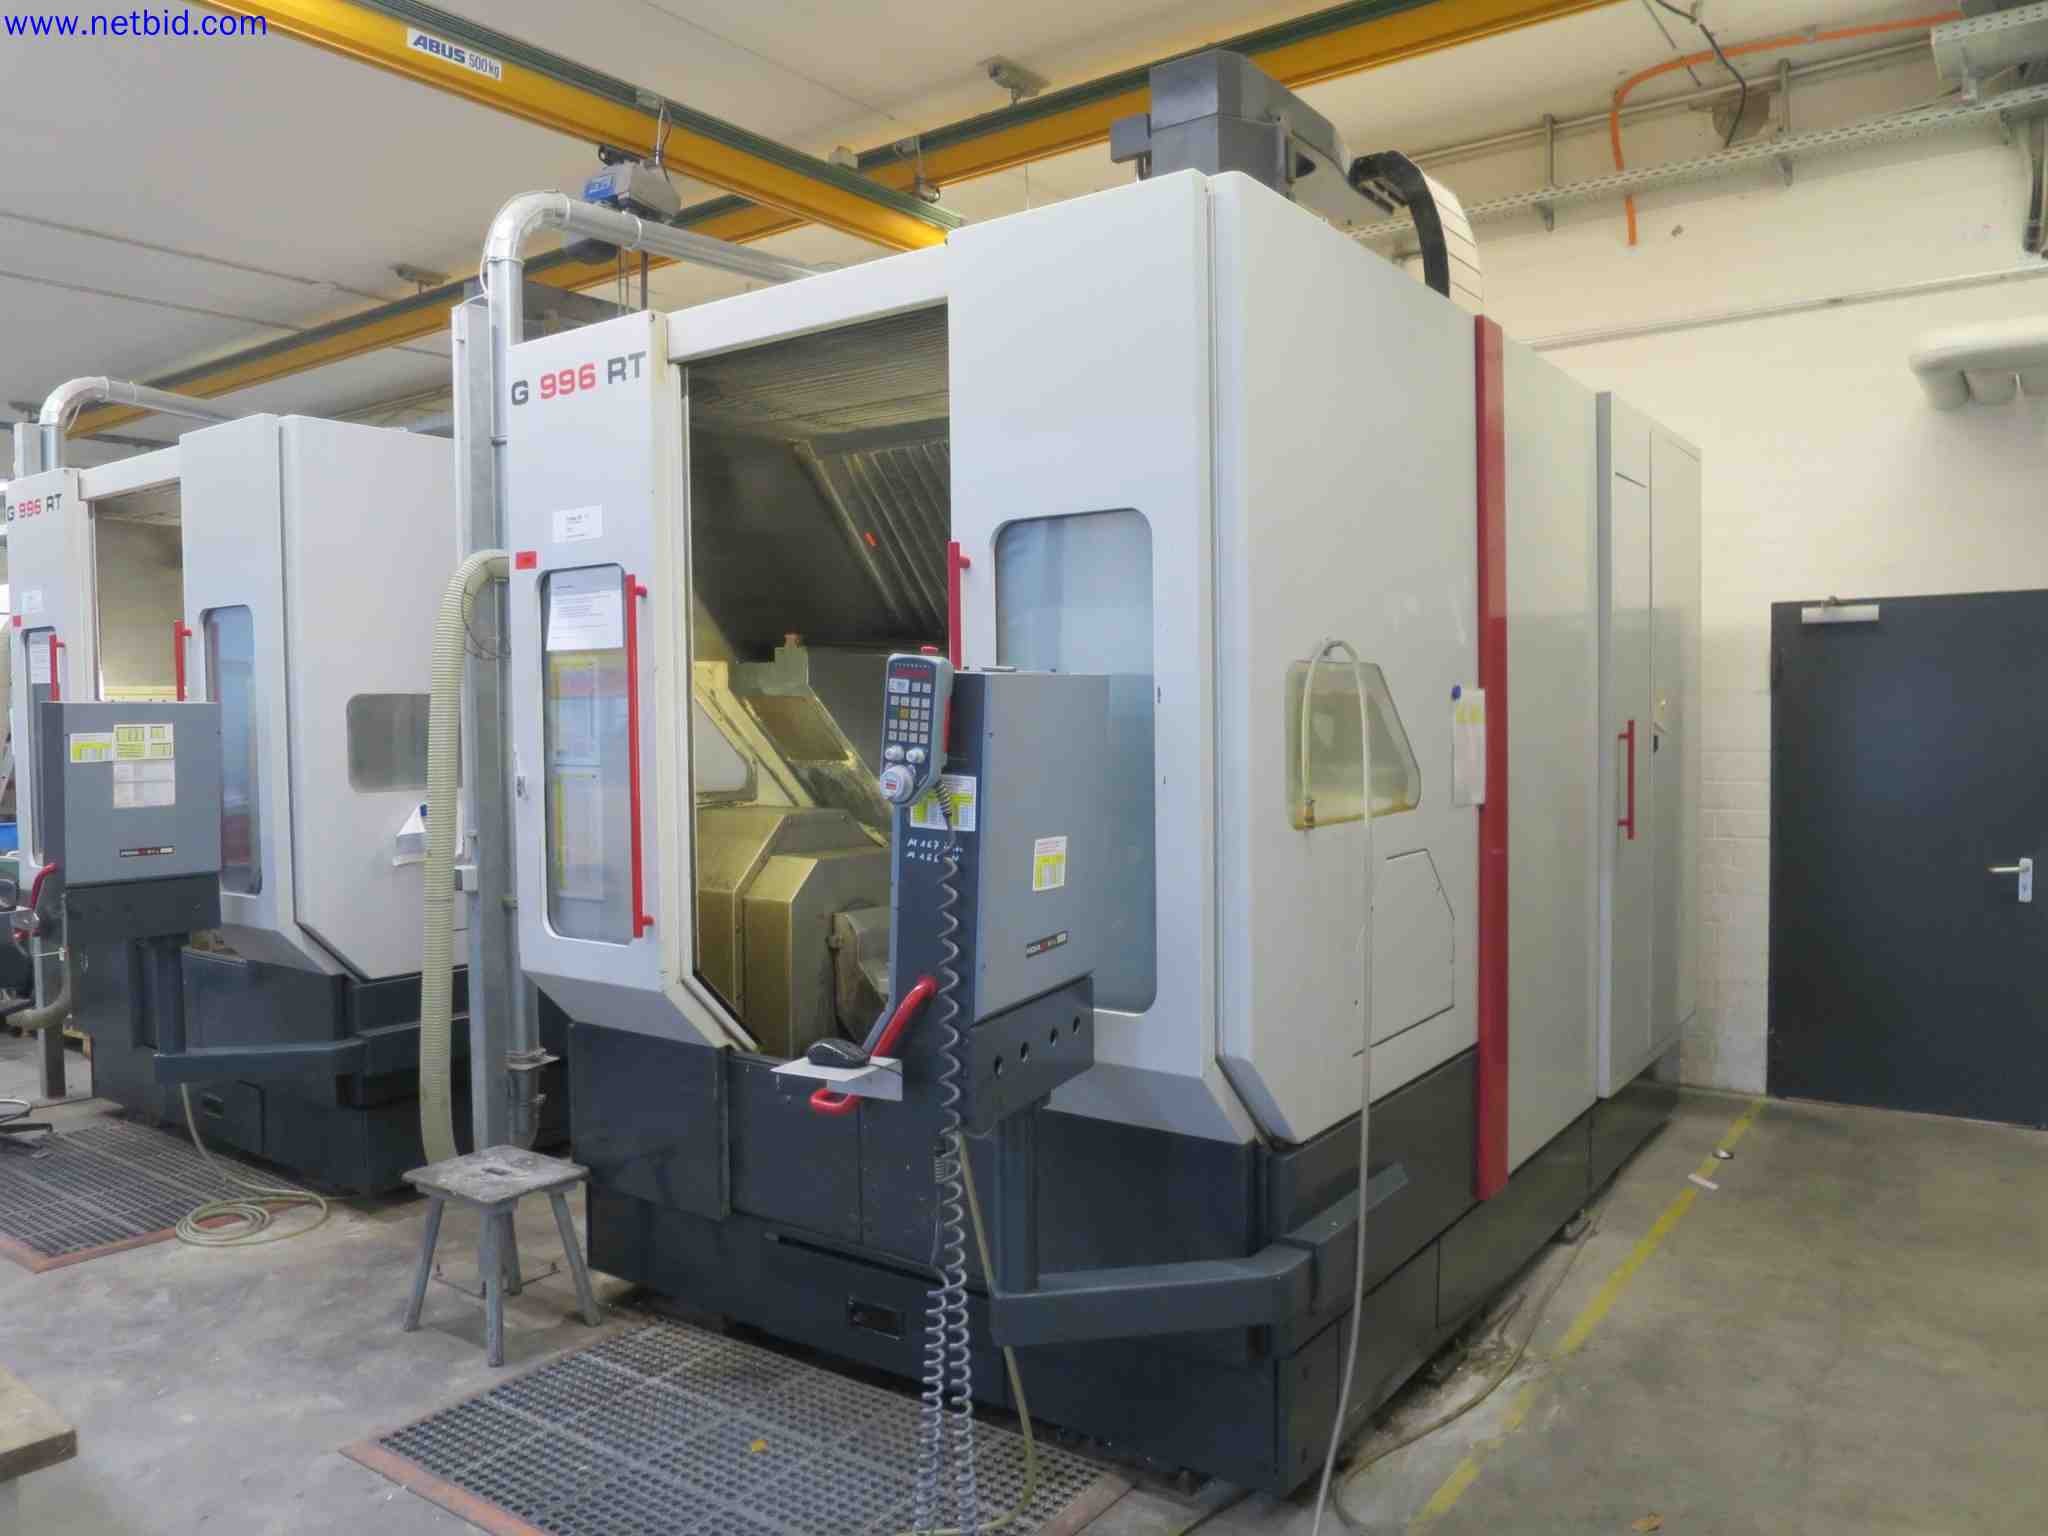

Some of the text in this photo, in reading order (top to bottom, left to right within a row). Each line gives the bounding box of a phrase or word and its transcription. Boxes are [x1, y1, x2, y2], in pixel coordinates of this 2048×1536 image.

[413, 35, 466, 64] ABUS
[511, 351, 647, 406] G 996 RT
[7, 493, 63, 522] G 996 RT
